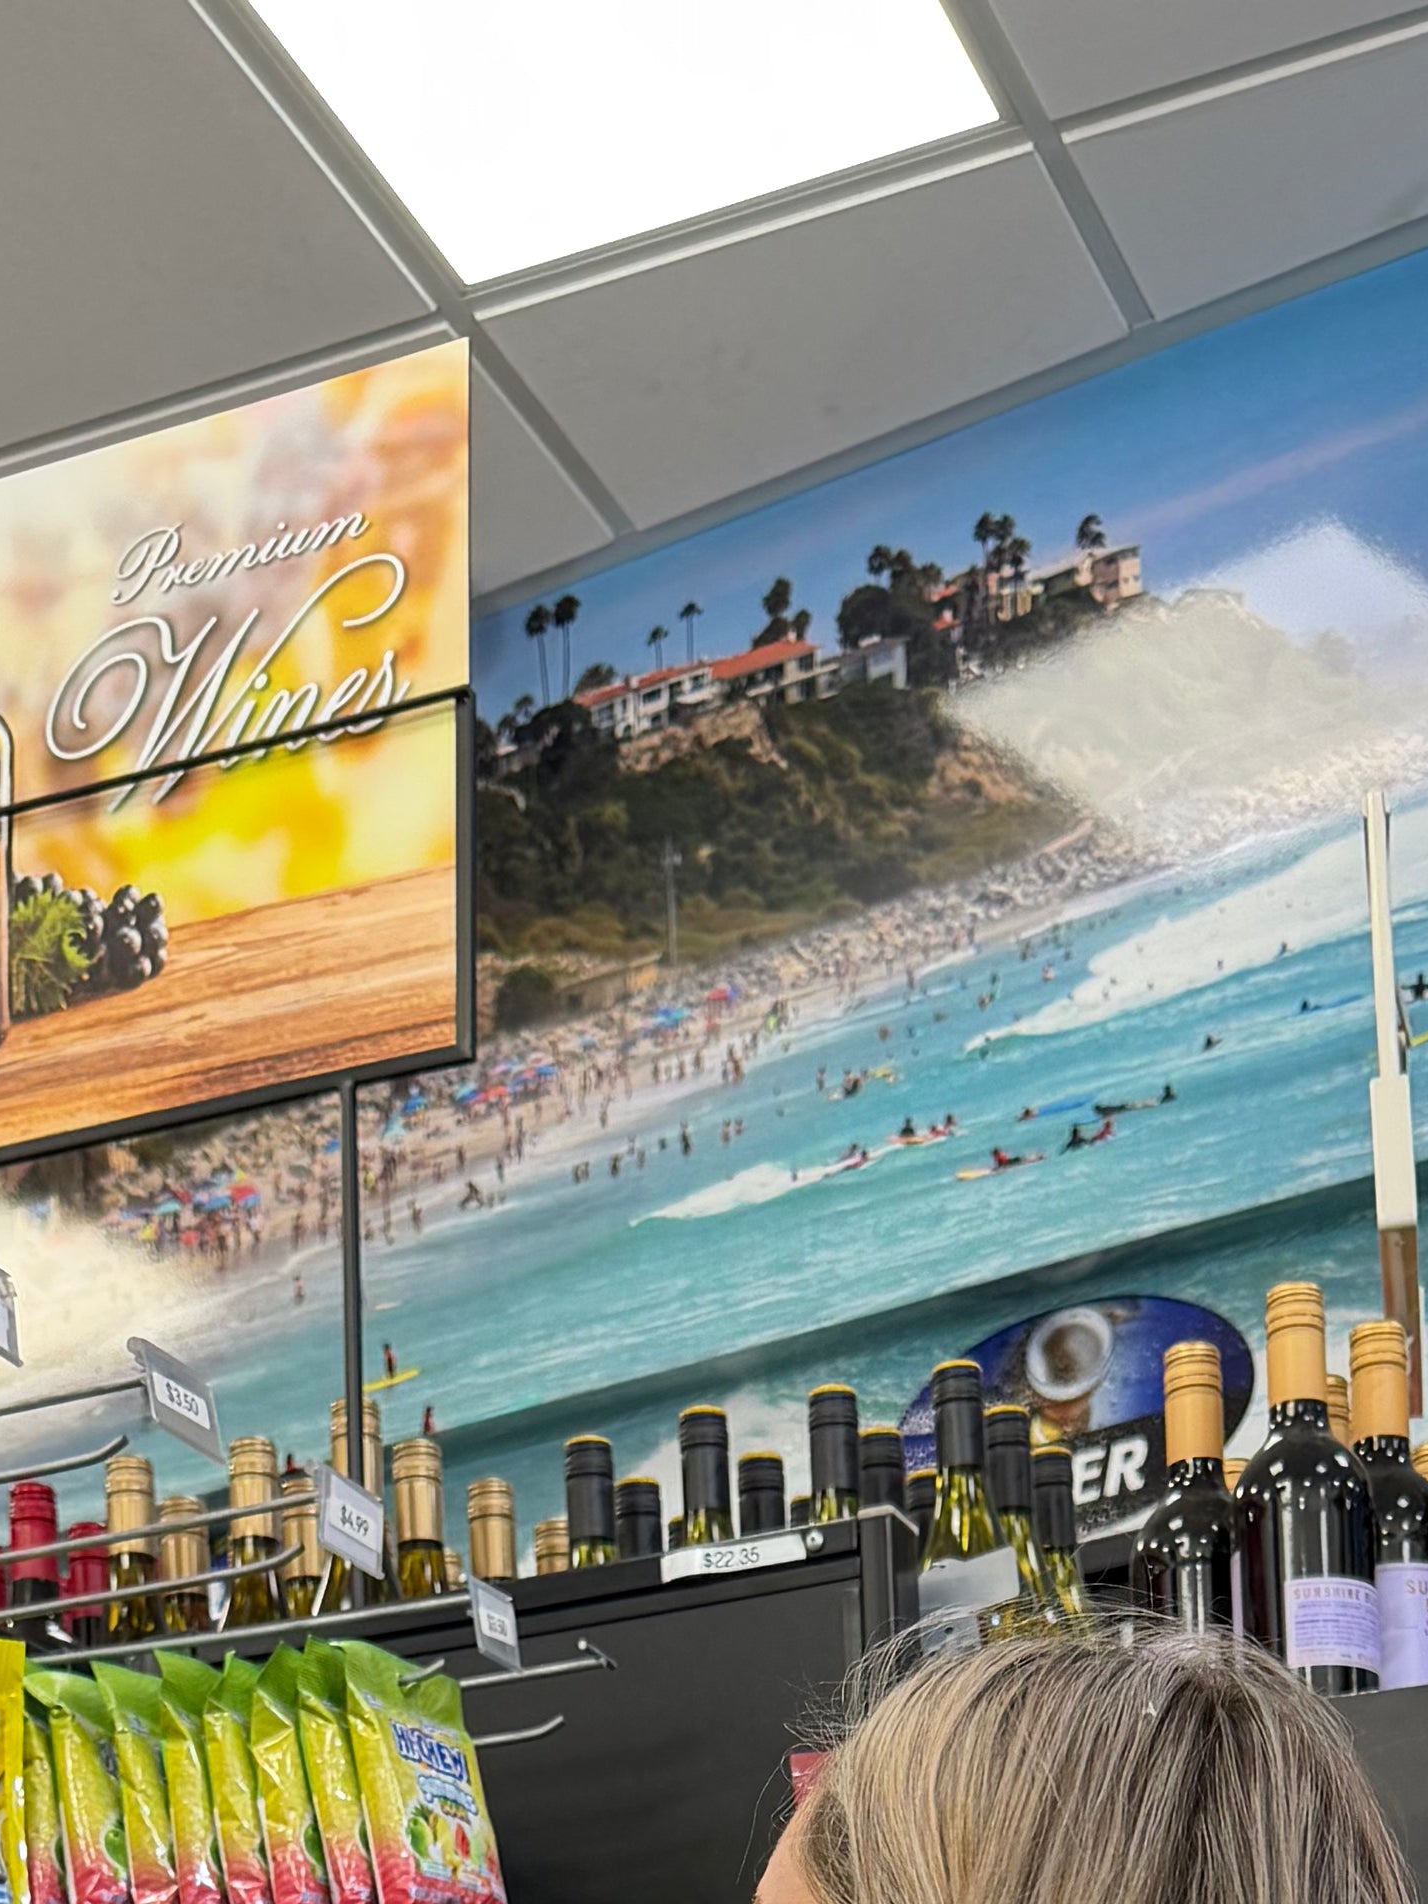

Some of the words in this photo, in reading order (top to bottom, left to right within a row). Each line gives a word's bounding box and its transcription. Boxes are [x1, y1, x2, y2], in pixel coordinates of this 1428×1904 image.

[113, 511, 369, 605] Premium
[47, 553, 410, 813] Wines
[340, 1507, 369, 1538] $4.99
[703, 1545, 760, 1569] $22.35
[1293, 1584, 1365, 1603] SUNSHINE
